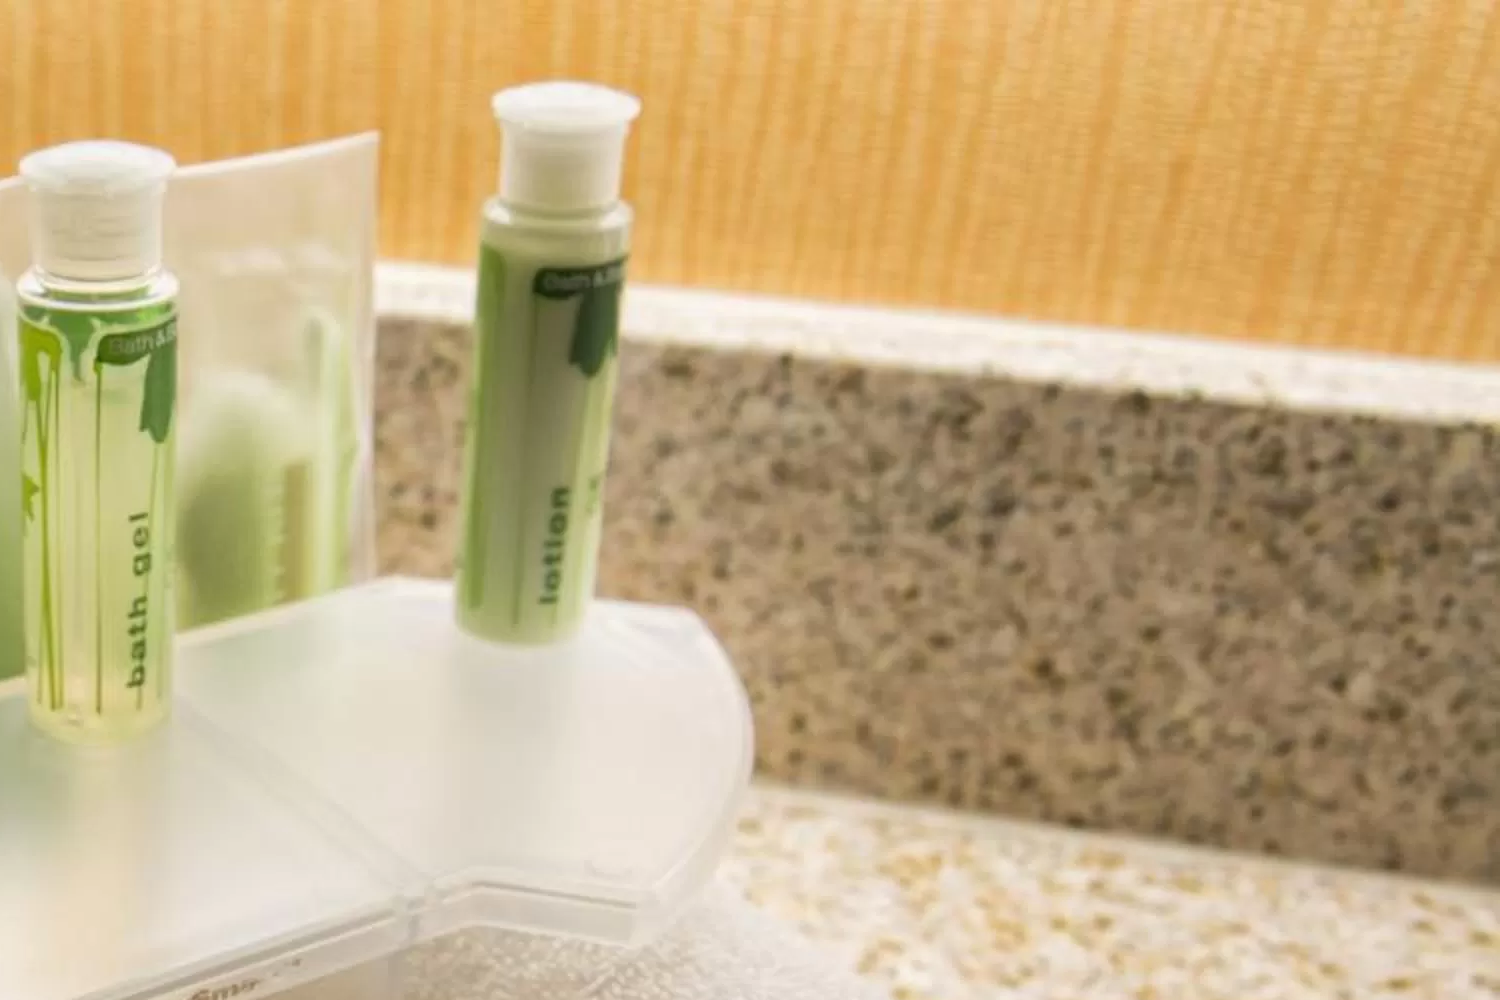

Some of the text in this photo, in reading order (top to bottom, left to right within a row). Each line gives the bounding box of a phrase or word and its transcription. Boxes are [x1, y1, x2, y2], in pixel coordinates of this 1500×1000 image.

[126, 512, 152, 688] bath gel
[537, 486, 571, 605] lotion
